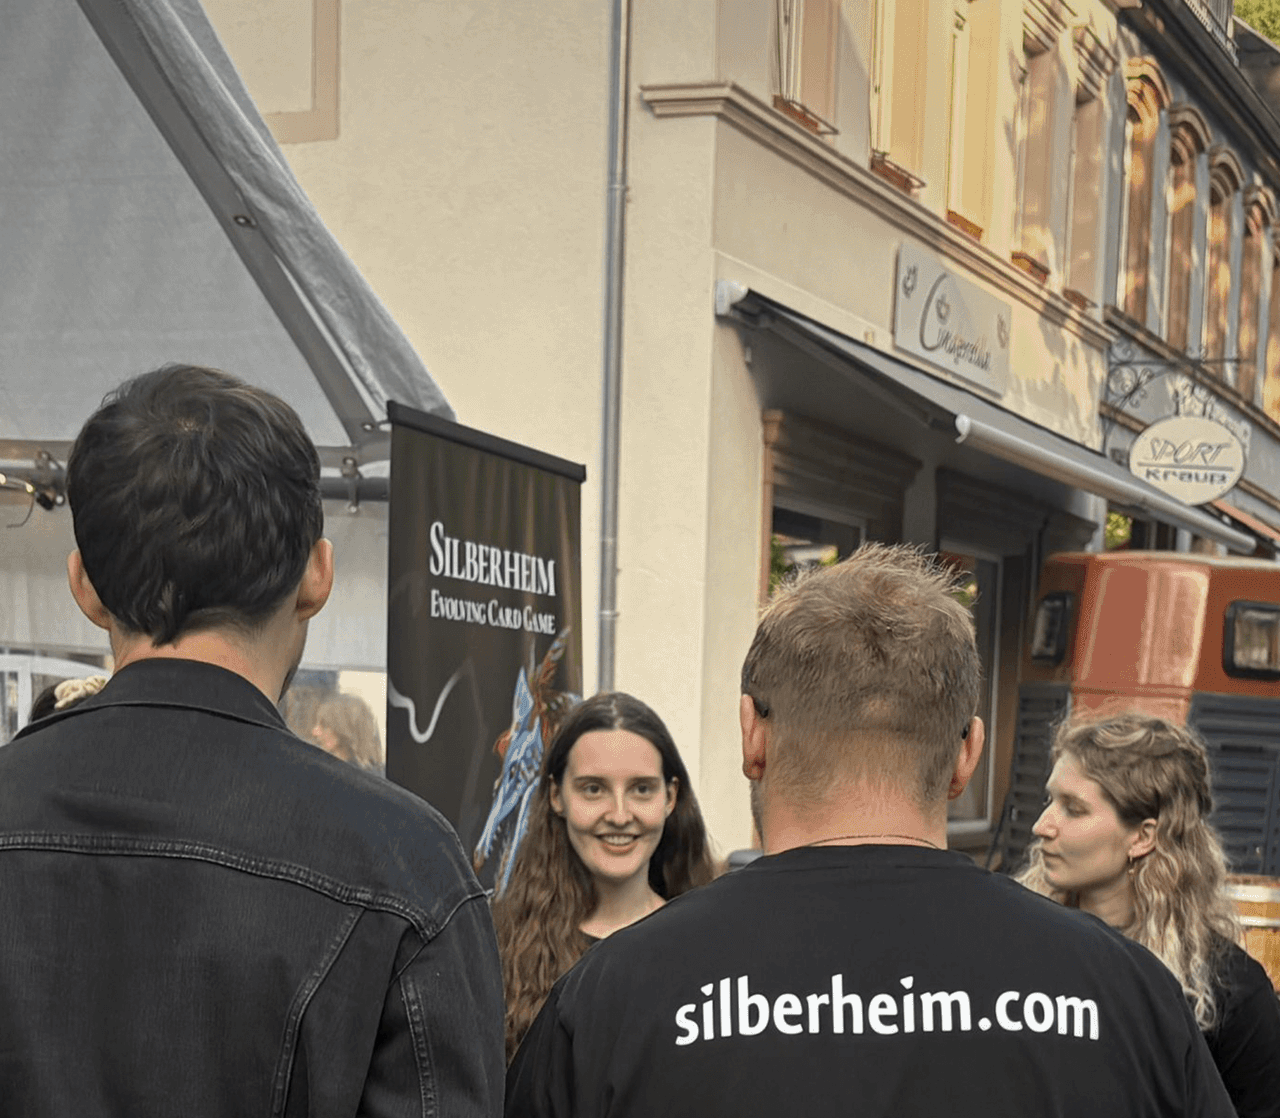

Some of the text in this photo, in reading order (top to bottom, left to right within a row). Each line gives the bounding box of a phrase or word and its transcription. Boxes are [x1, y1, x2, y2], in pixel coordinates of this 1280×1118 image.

[1150, 437, 1232, 464] SPORT
[429, 521, 557, 597] SILBERHEIM
[430, 589, 556, 635] EVOLVING CARD GAME
[674, 973, 1101, 1047] silberheim.com
